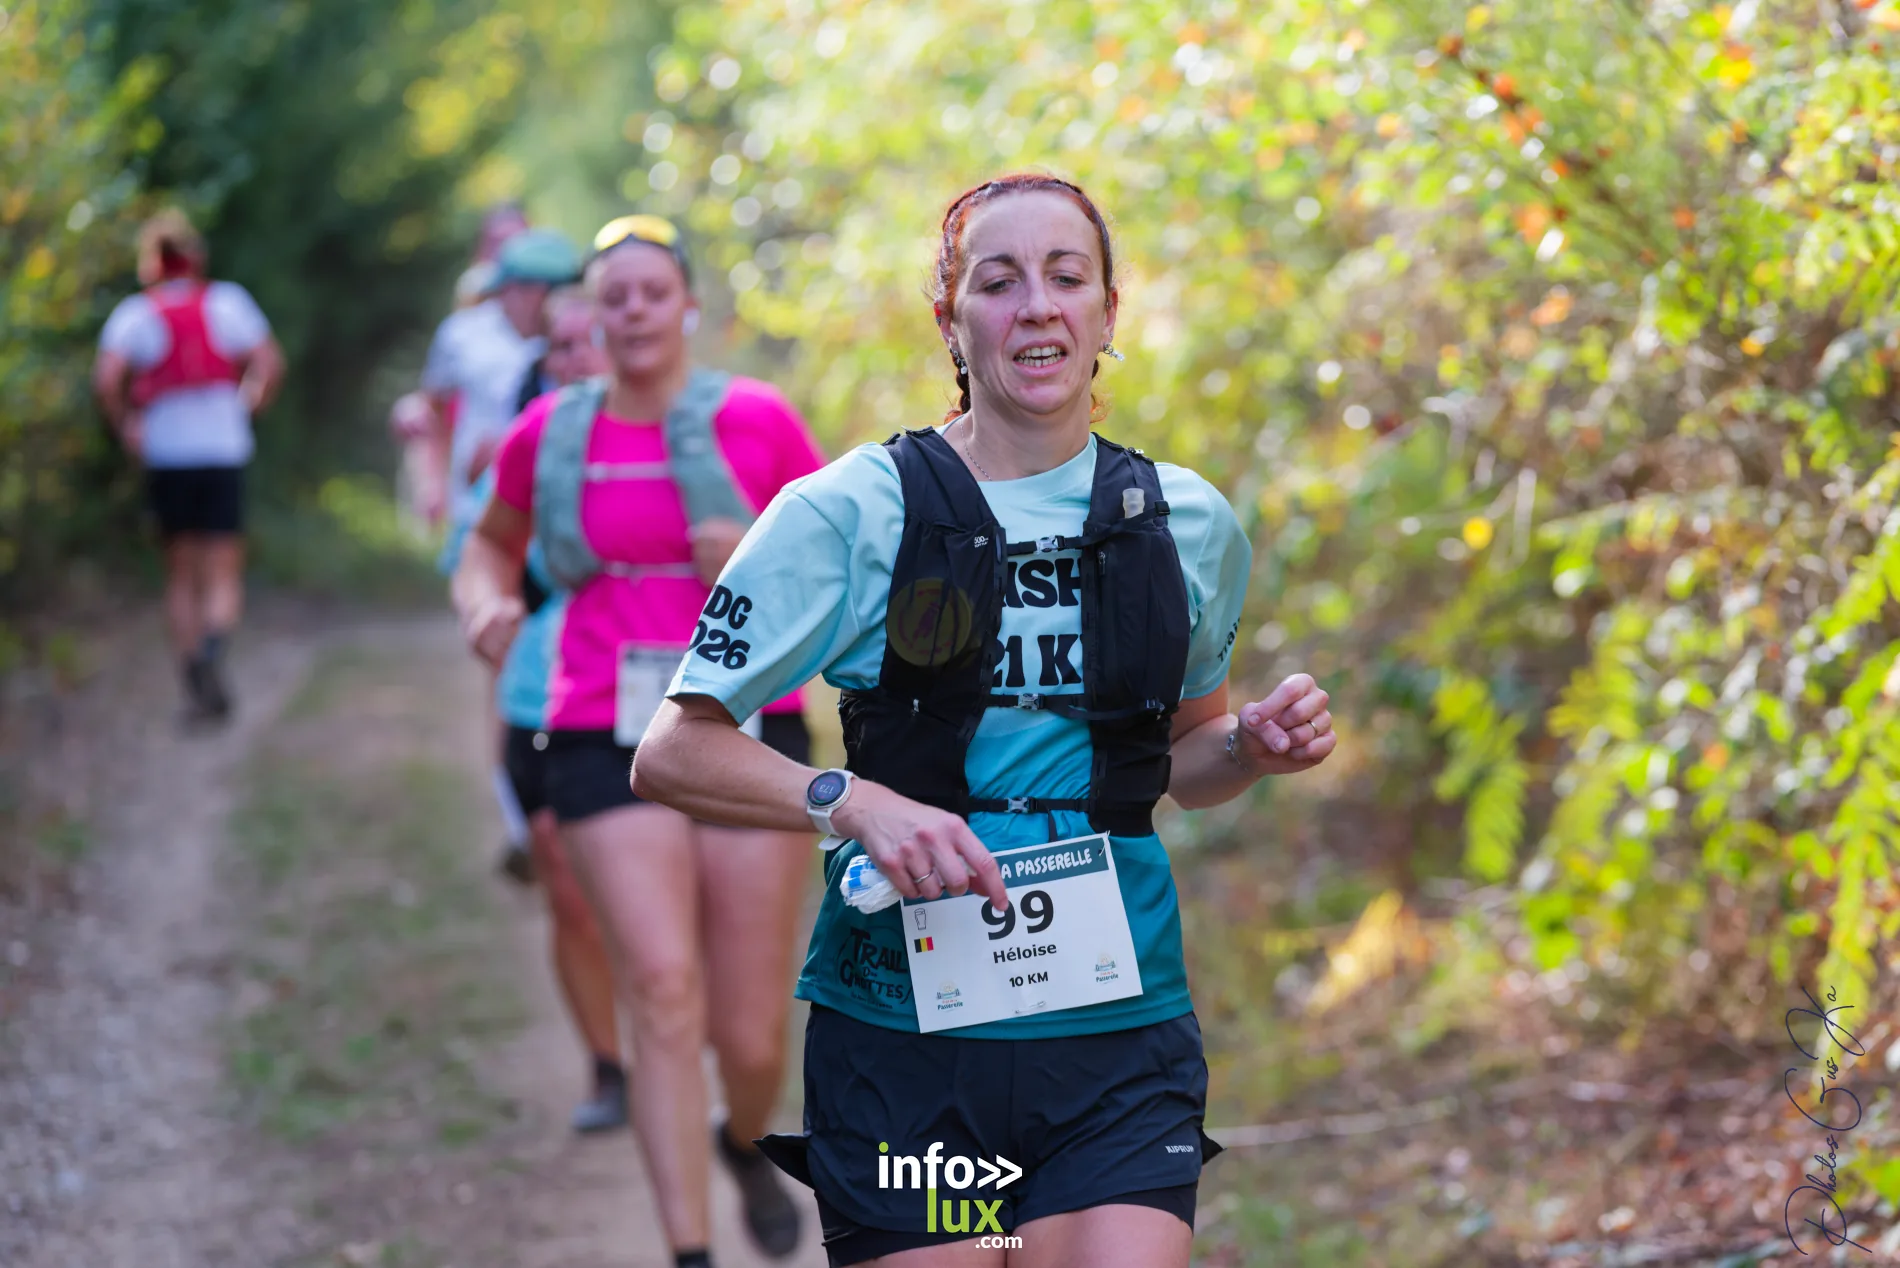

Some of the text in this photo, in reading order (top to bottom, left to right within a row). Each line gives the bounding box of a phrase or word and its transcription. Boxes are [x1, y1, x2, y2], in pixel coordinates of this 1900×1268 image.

[703, 584, 753, 630] DG
[1002, 558, 1082, 609] ISH
[688, 619, 751, 670] 026
[1037, 633, 1084, 687] K
[1000, 847, 1093, 880] A PASSERELLE
[981, 889, 1054, 941] 99
[850, 926, 908, 974] TRAIL
[993, 943, 1057, 964] Héloise
[1009, 971, 1049, 988] 10 KM
